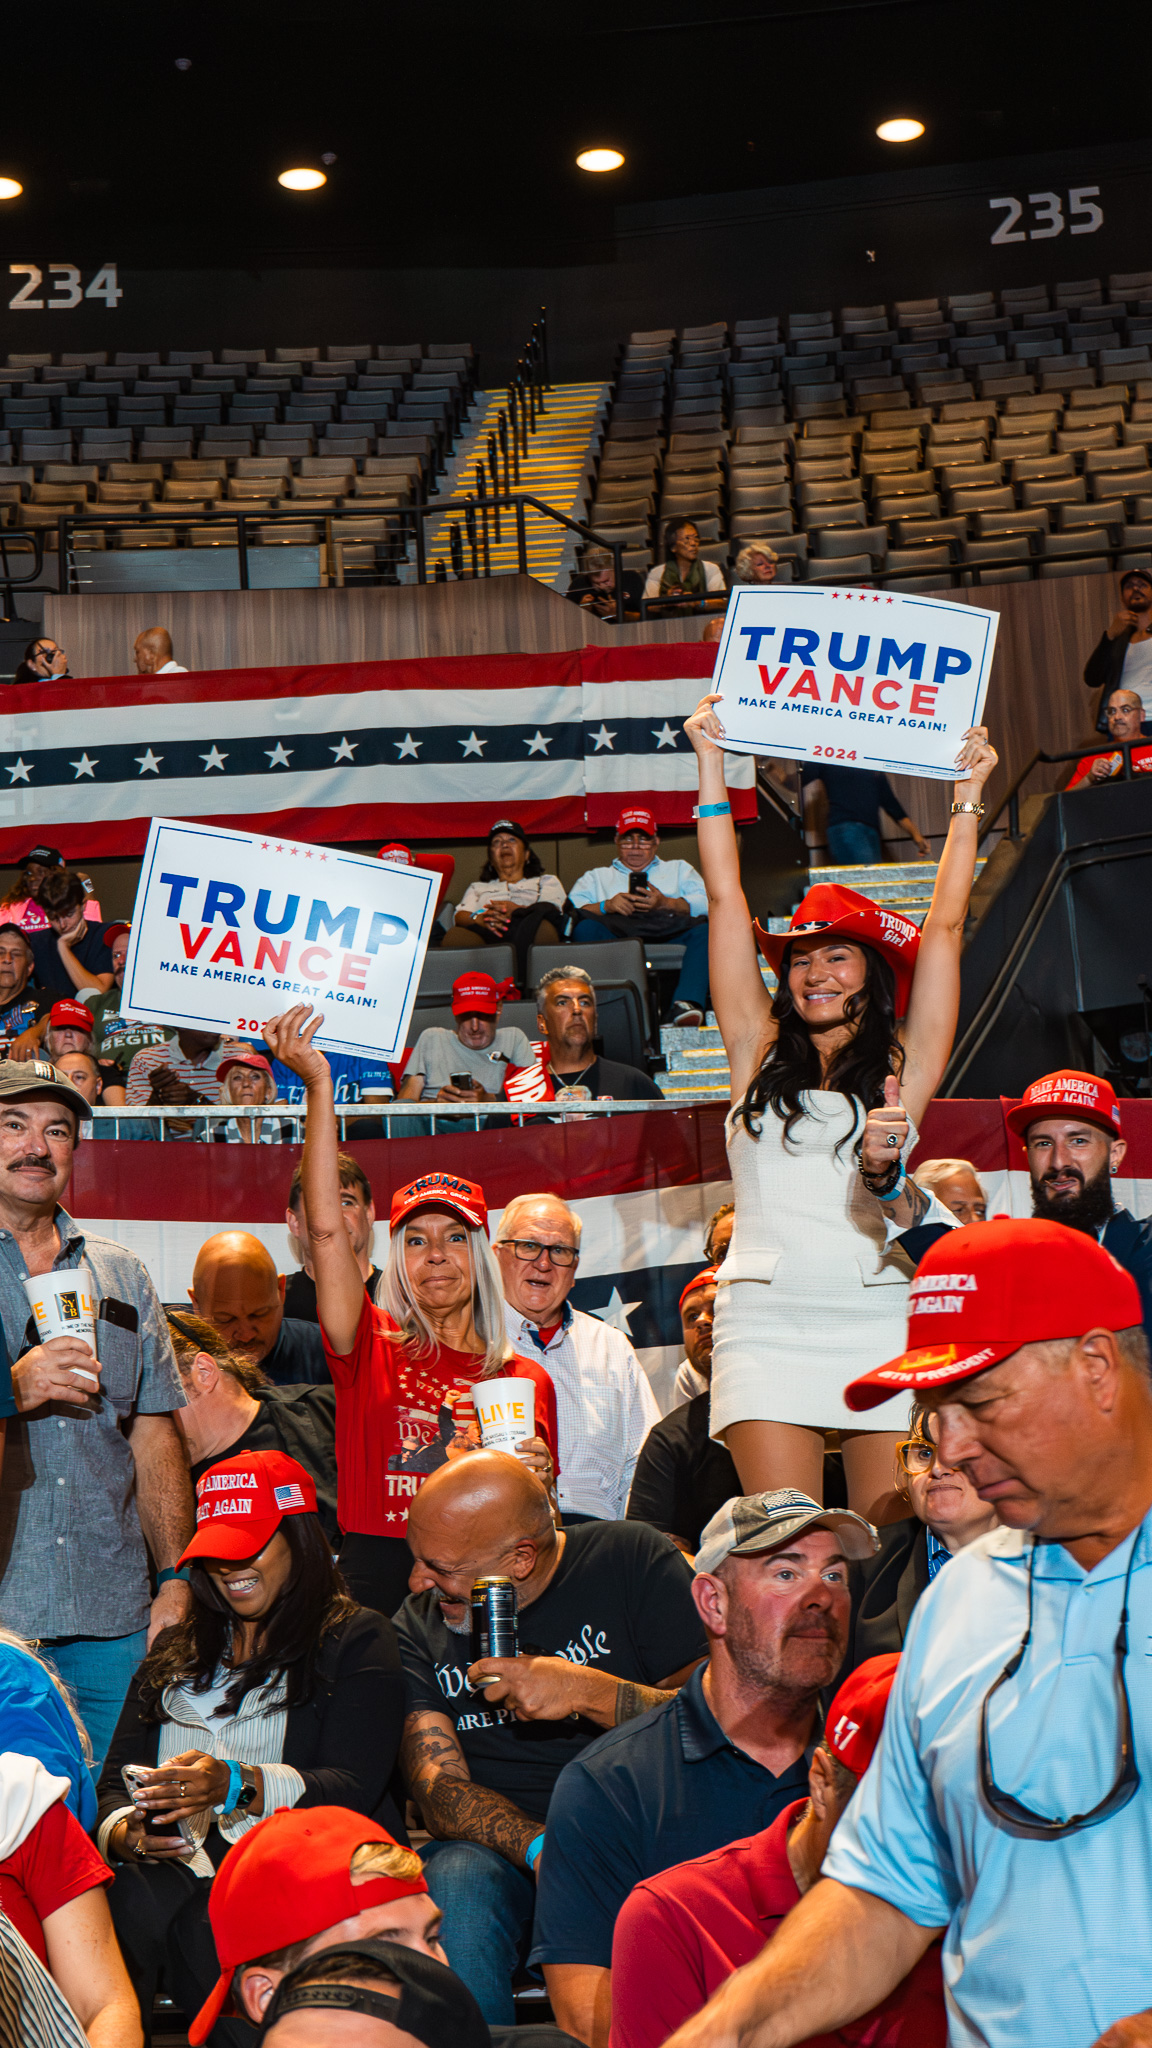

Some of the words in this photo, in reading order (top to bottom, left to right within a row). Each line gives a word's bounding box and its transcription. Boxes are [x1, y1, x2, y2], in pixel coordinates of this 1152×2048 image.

[989, 186, 1103, 244] 235
[9, 263, 123, 309] 234
[740, 627, 973, 684] TRUMP
[758, 664, 939, 717] VANCE
[738, 696, 777, 709] MAKE
[781, 702, 843, 718] AMERICA
[848, 711, 893, 725] GREAT
[898, 718, 947, 732] AGAIN!
[813, 745, 858, 761] 2024
[160, 872, 409, 955] TRUMP
[879, 911, 916, 942] TRUMP
[882, 929, 907, 947] Girl
[179, 923, 372, 991] VANCE
[160, 961, 199, 977] MAKE
[203, 968, 266, 988] AMERICA
[272, 980, 321, 997] GREAT
[325, 990, 378, 1009] AGAIN!
[101, 1033, 165, 1053] BEGIN
[1029, 1080, 1053, 1100] MAKE
[1053, 1078, 1099, 1098] AMERICA
[1062, 1092, 1095, 1107] AGAIN
[404, 1174, 472, 1196] TRUMP
[420, 1189, 448, 1198] AMERICA
[450, 1191, 470, 1202] GREAT
[915, 1295, 965, 1314] AGAIN
[915, 1348, 995, 1381] PRESIDENT
[415, 1378, 443, 1399] 1776
[480, 1402, 525, 1424] LIVE
[203, 1472, 258, 1491] AMERICA
[385, 1474, 427, 1497] TRU
[212, 1498, 252, 1516] AGAIN
[457, 1713, 494, 1731] ARE
[834, 1714, 860, 1751] 47
